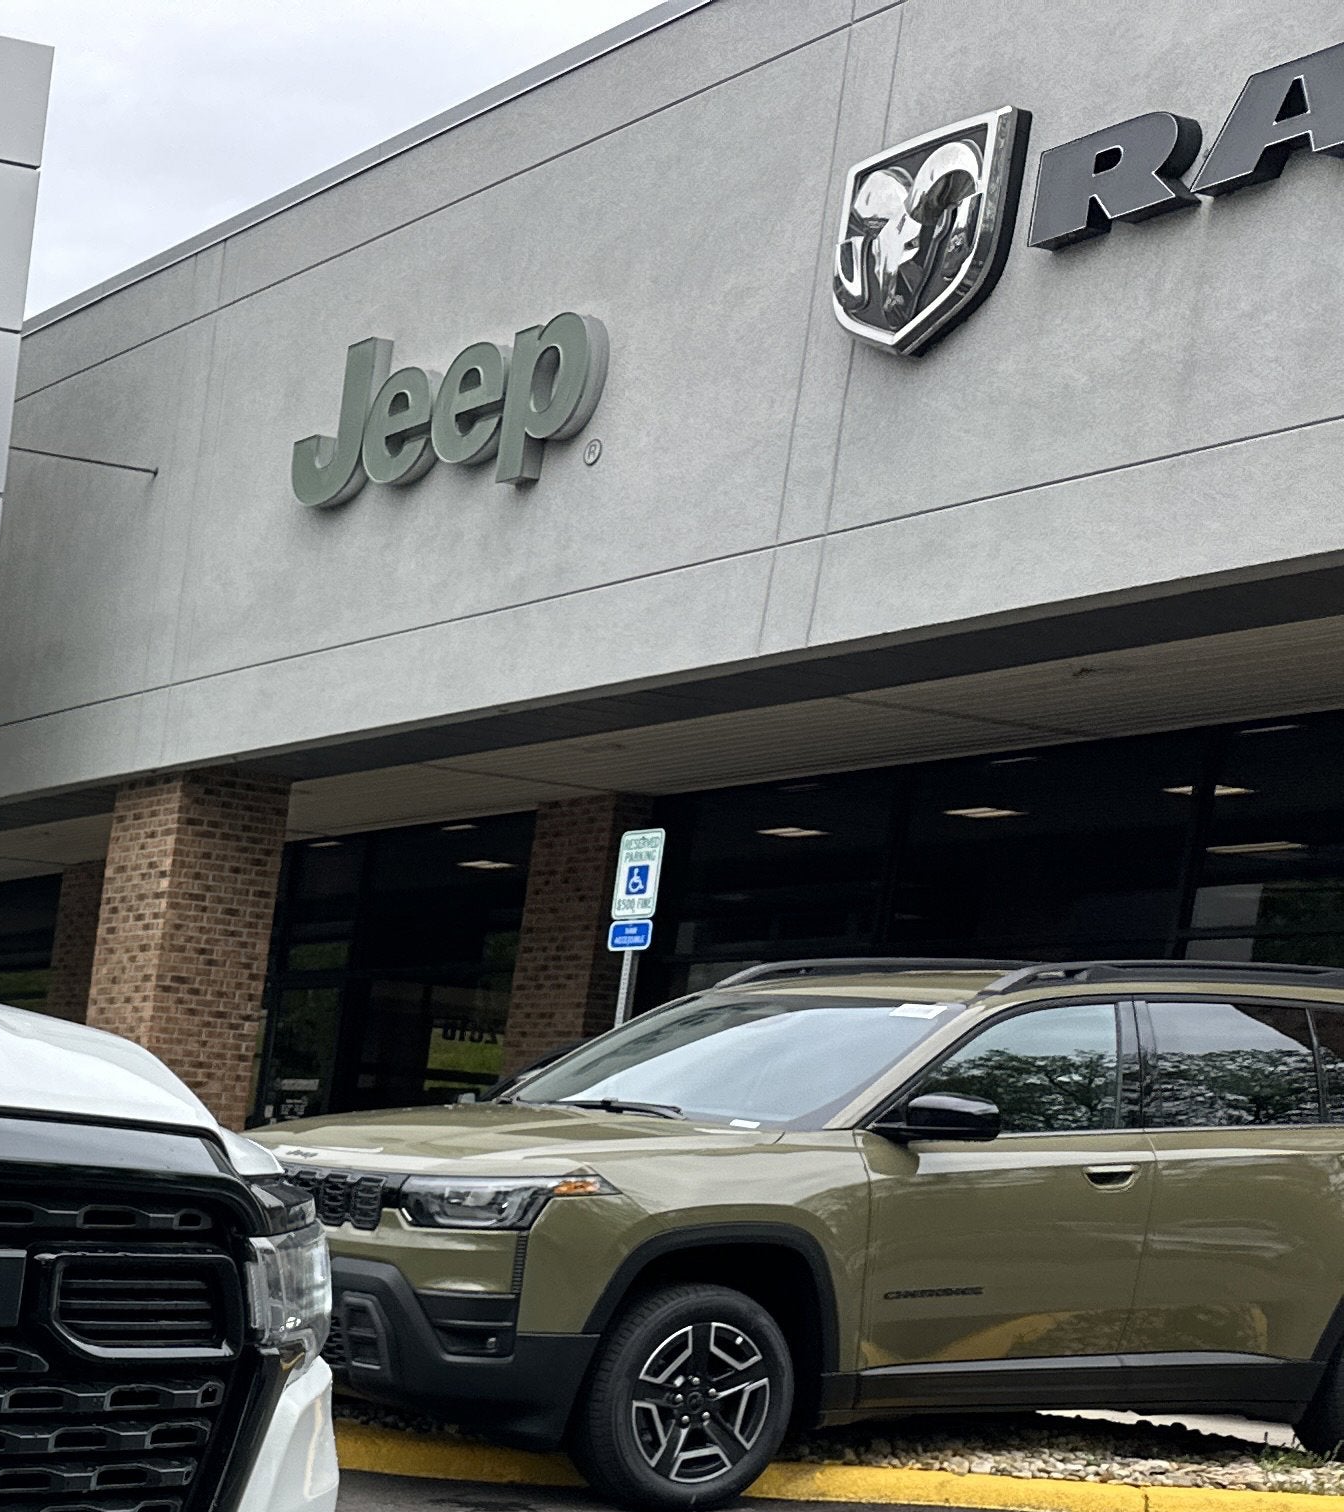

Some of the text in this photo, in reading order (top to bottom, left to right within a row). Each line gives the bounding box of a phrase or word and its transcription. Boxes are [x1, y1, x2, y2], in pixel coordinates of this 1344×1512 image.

[291, 312, 610, 508] Jeep
[624, 836, 660, 850] RESERVED
[624, 850, 657, 863] PARKING
